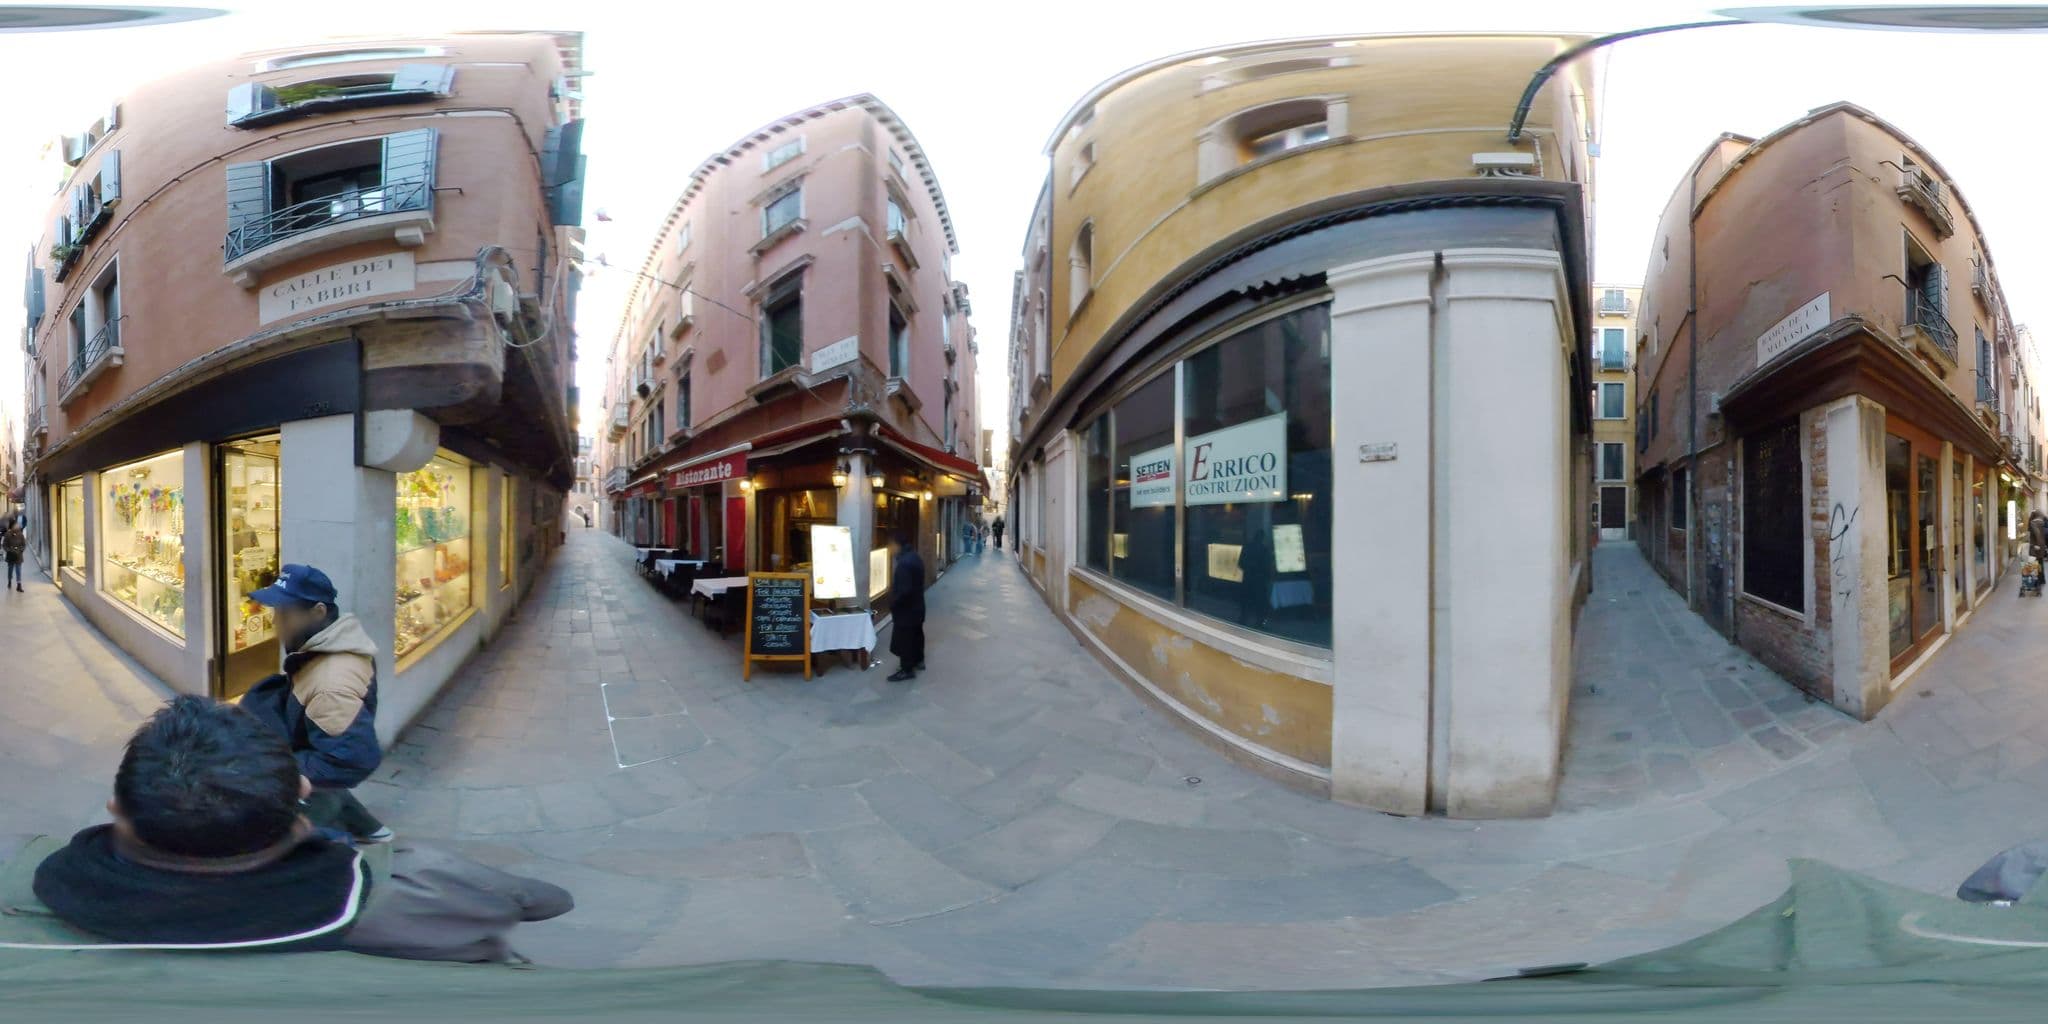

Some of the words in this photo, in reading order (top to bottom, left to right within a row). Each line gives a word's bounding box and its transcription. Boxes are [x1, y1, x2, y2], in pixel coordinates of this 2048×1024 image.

[273, 269, 342, 298] CALLE
[353, 259, 393, 276] DEI
[290, 279, 375, 310] FABBRI
[1788, 316, 1799, 328] DE
[1804, 303, 1820, 318] LA
[675, 461, 733, 486] Ristorante
[1136, 458, 1171, 478] SETTEN
[1189, 442, 1277, 483] ERRICO
[1188, 474, 1277, 496] COSTRUZIONI
